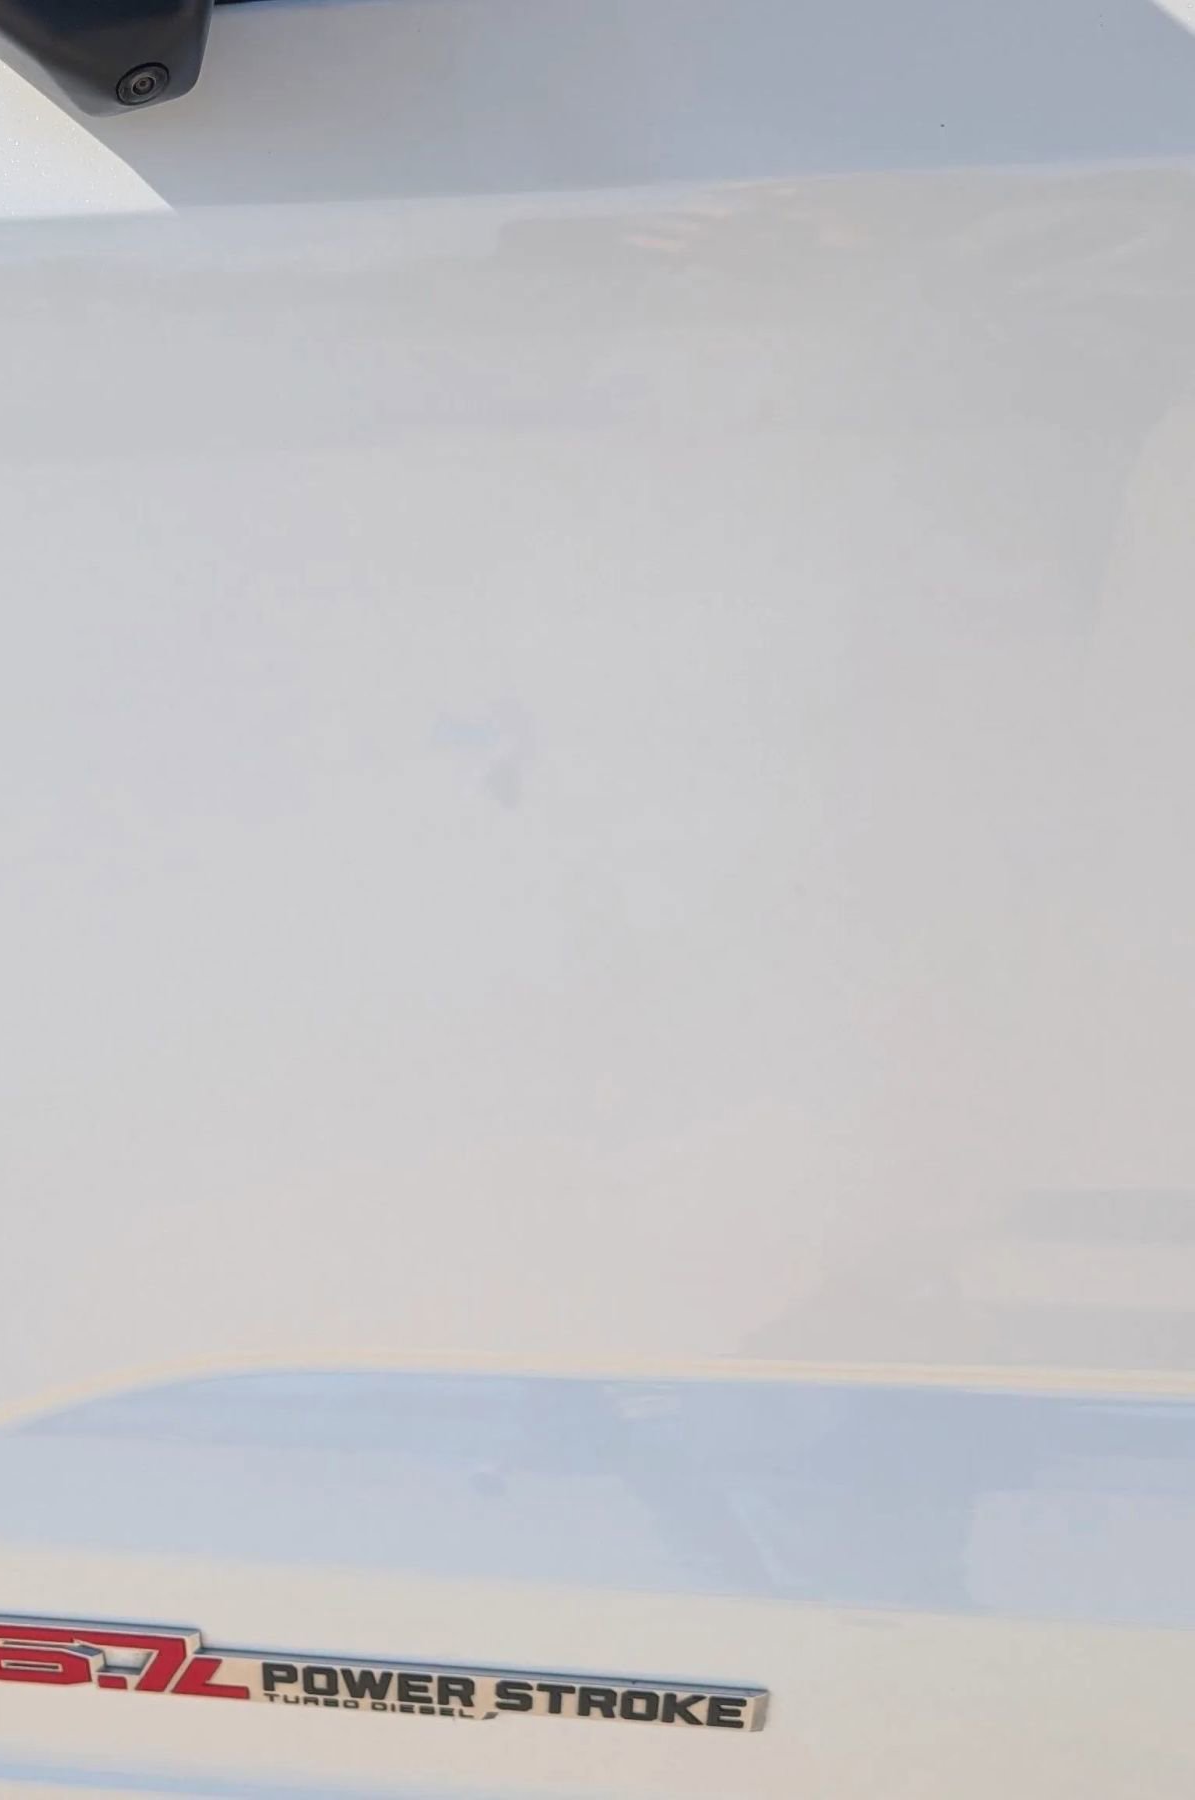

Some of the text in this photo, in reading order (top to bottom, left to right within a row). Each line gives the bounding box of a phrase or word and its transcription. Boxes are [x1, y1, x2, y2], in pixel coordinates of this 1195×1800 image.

[261, 1661, 475, 1707] POWER
[494, 1679, 747, 1729] STROKE
[264, 1692, 474, 1718] TURBO DIESEL
